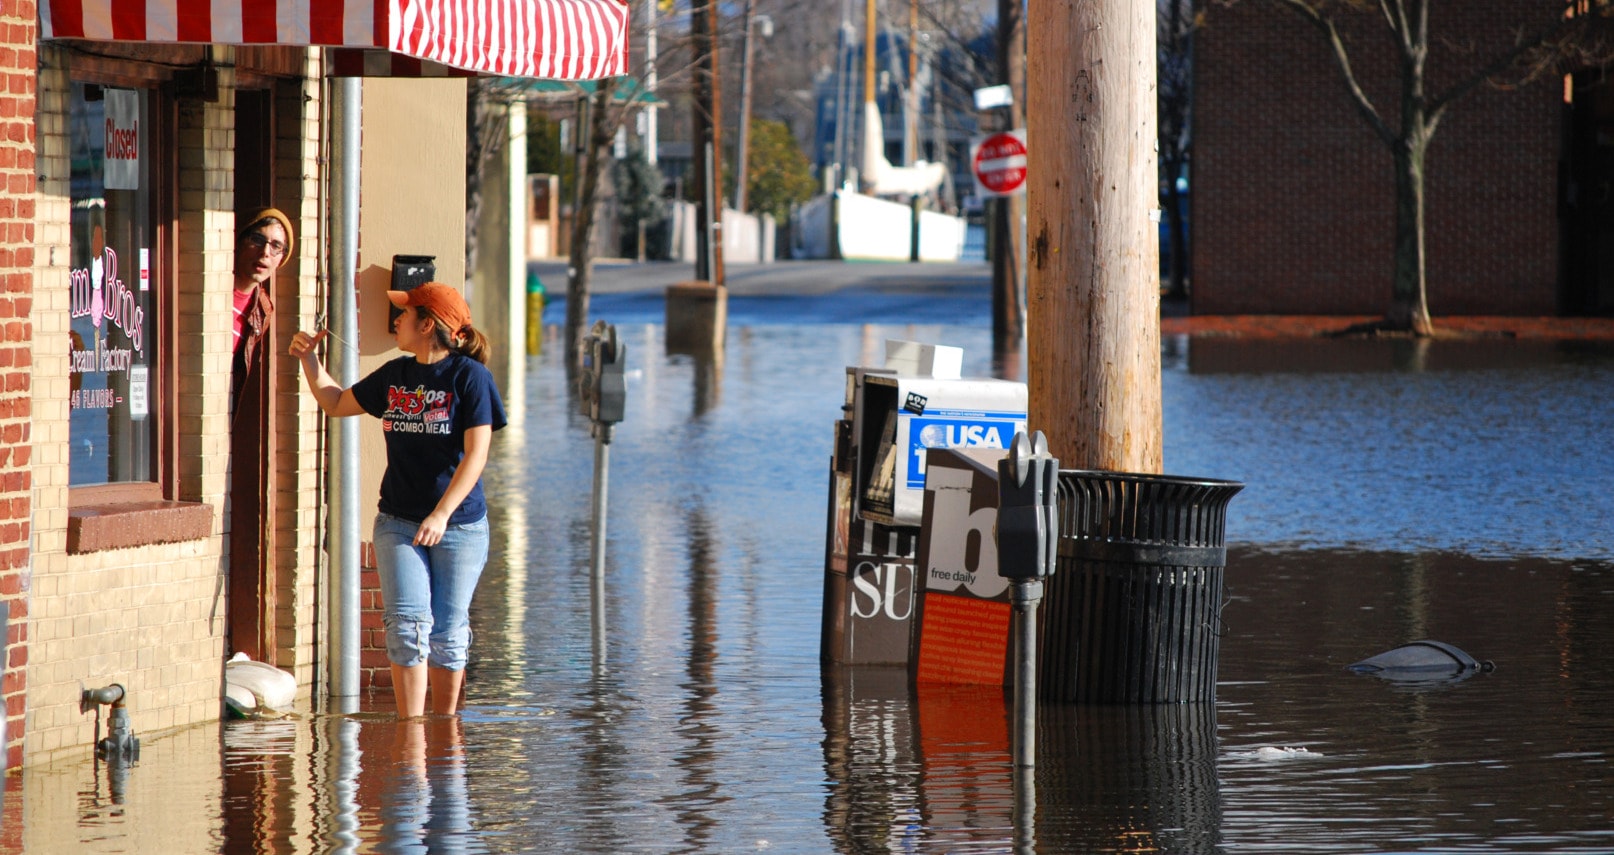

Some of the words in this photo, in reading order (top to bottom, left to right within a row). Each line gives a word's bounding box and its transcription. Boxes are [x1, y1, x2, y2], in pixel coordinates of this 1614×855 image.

[105, 117, 138, 160] Closed
[100, 338, 132, 380] Factory
[82, 388, 114, 409] FLAVORS
[393, 421, 424, 433] COMBO
[426, 423, 452, 435] MEAL
[946, 424, 1003, 449] USA
[931, 567, 951, 580] free
[952, 570, 977, 585] daily
[850, 560, 914, 621] SU
